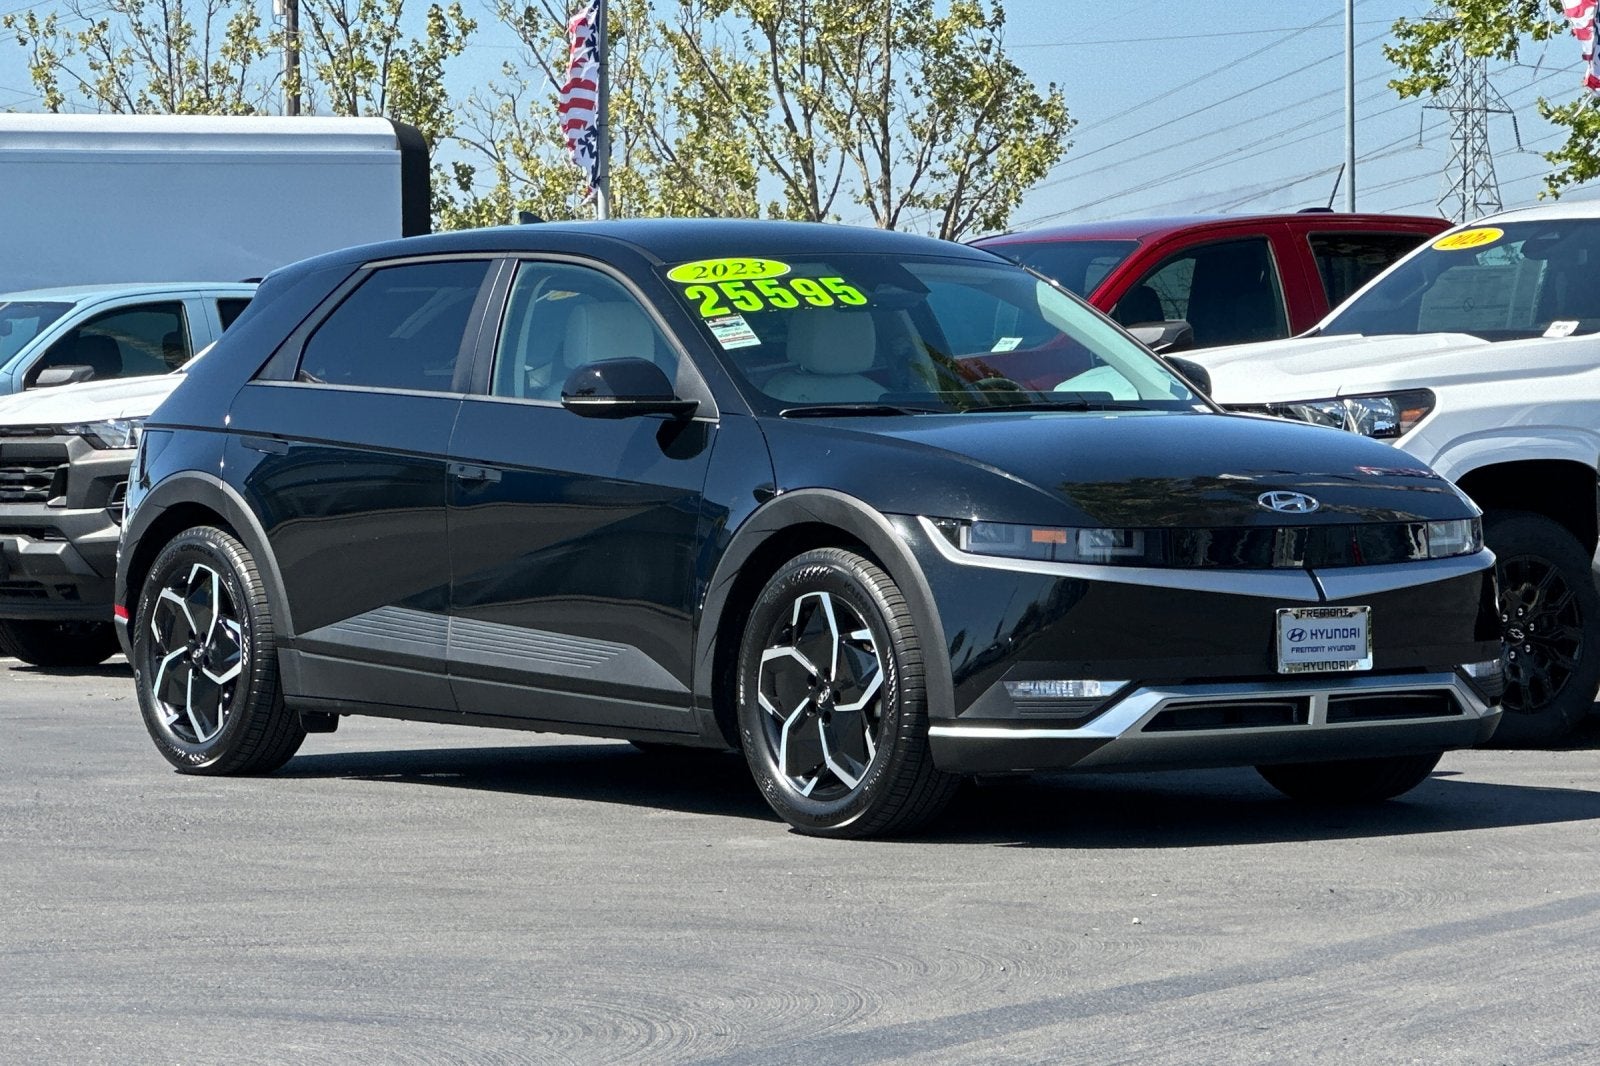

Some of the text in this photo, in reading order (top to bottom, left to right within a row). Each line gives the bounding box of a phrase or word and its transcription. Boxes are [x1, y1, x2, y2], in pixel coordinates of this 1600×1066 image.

[693, 261, 767, 280] 2023
[684, 277, 868, 318] 25595
[1300, 607, 1350, 619] FREMONT
[1310, 627, 1360, 640] HYUNDAI
[1291, 644, 1356, 654] FREMONT HYUNDAI
[1302, 660, 1350, 671] HYUNDAI
